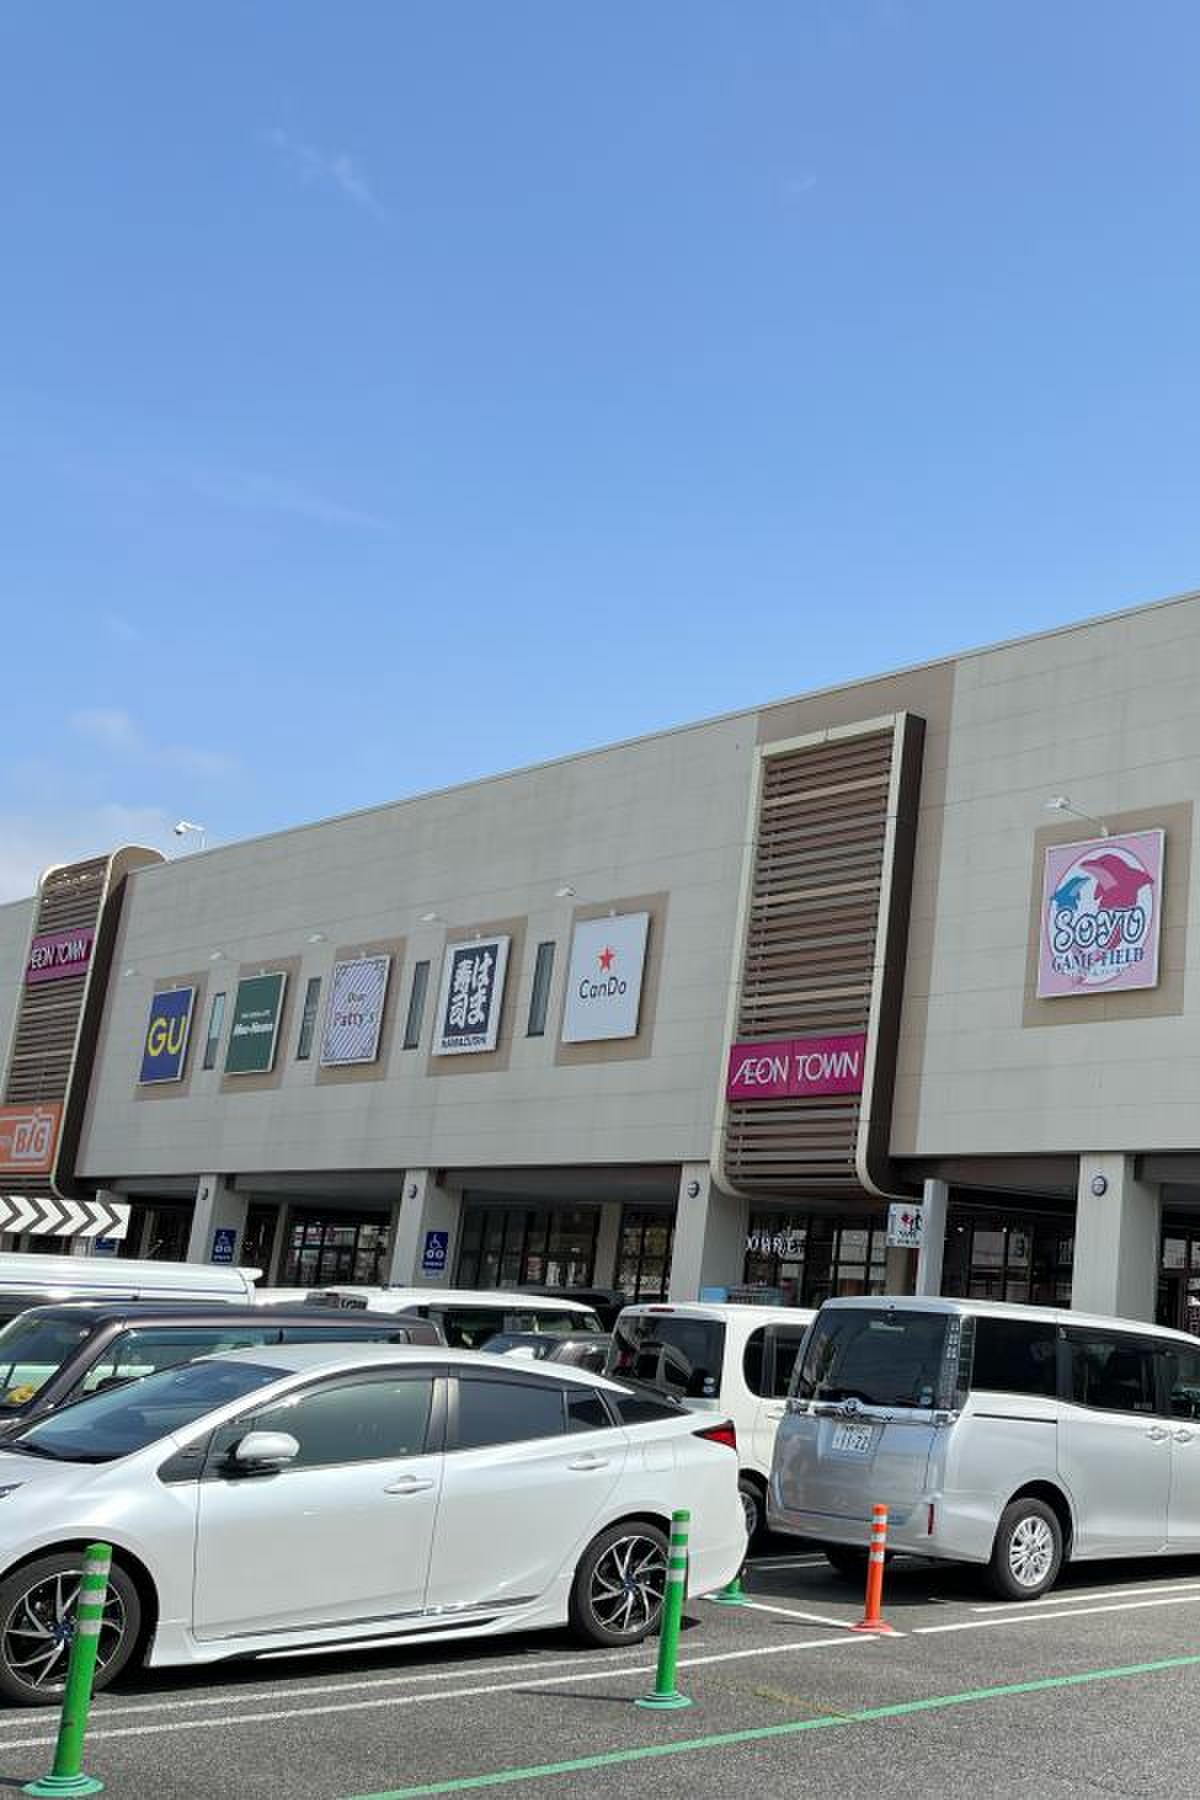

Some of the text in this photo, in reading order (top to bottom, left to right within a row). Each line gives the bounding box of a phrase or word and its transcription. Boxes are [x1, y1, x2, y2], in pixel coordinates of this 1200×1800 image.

[578, 976, 627, 1000] CanDo
[147, 1016, 187, 1057] GU
[795, 1051, 859, 1080] TOWN
